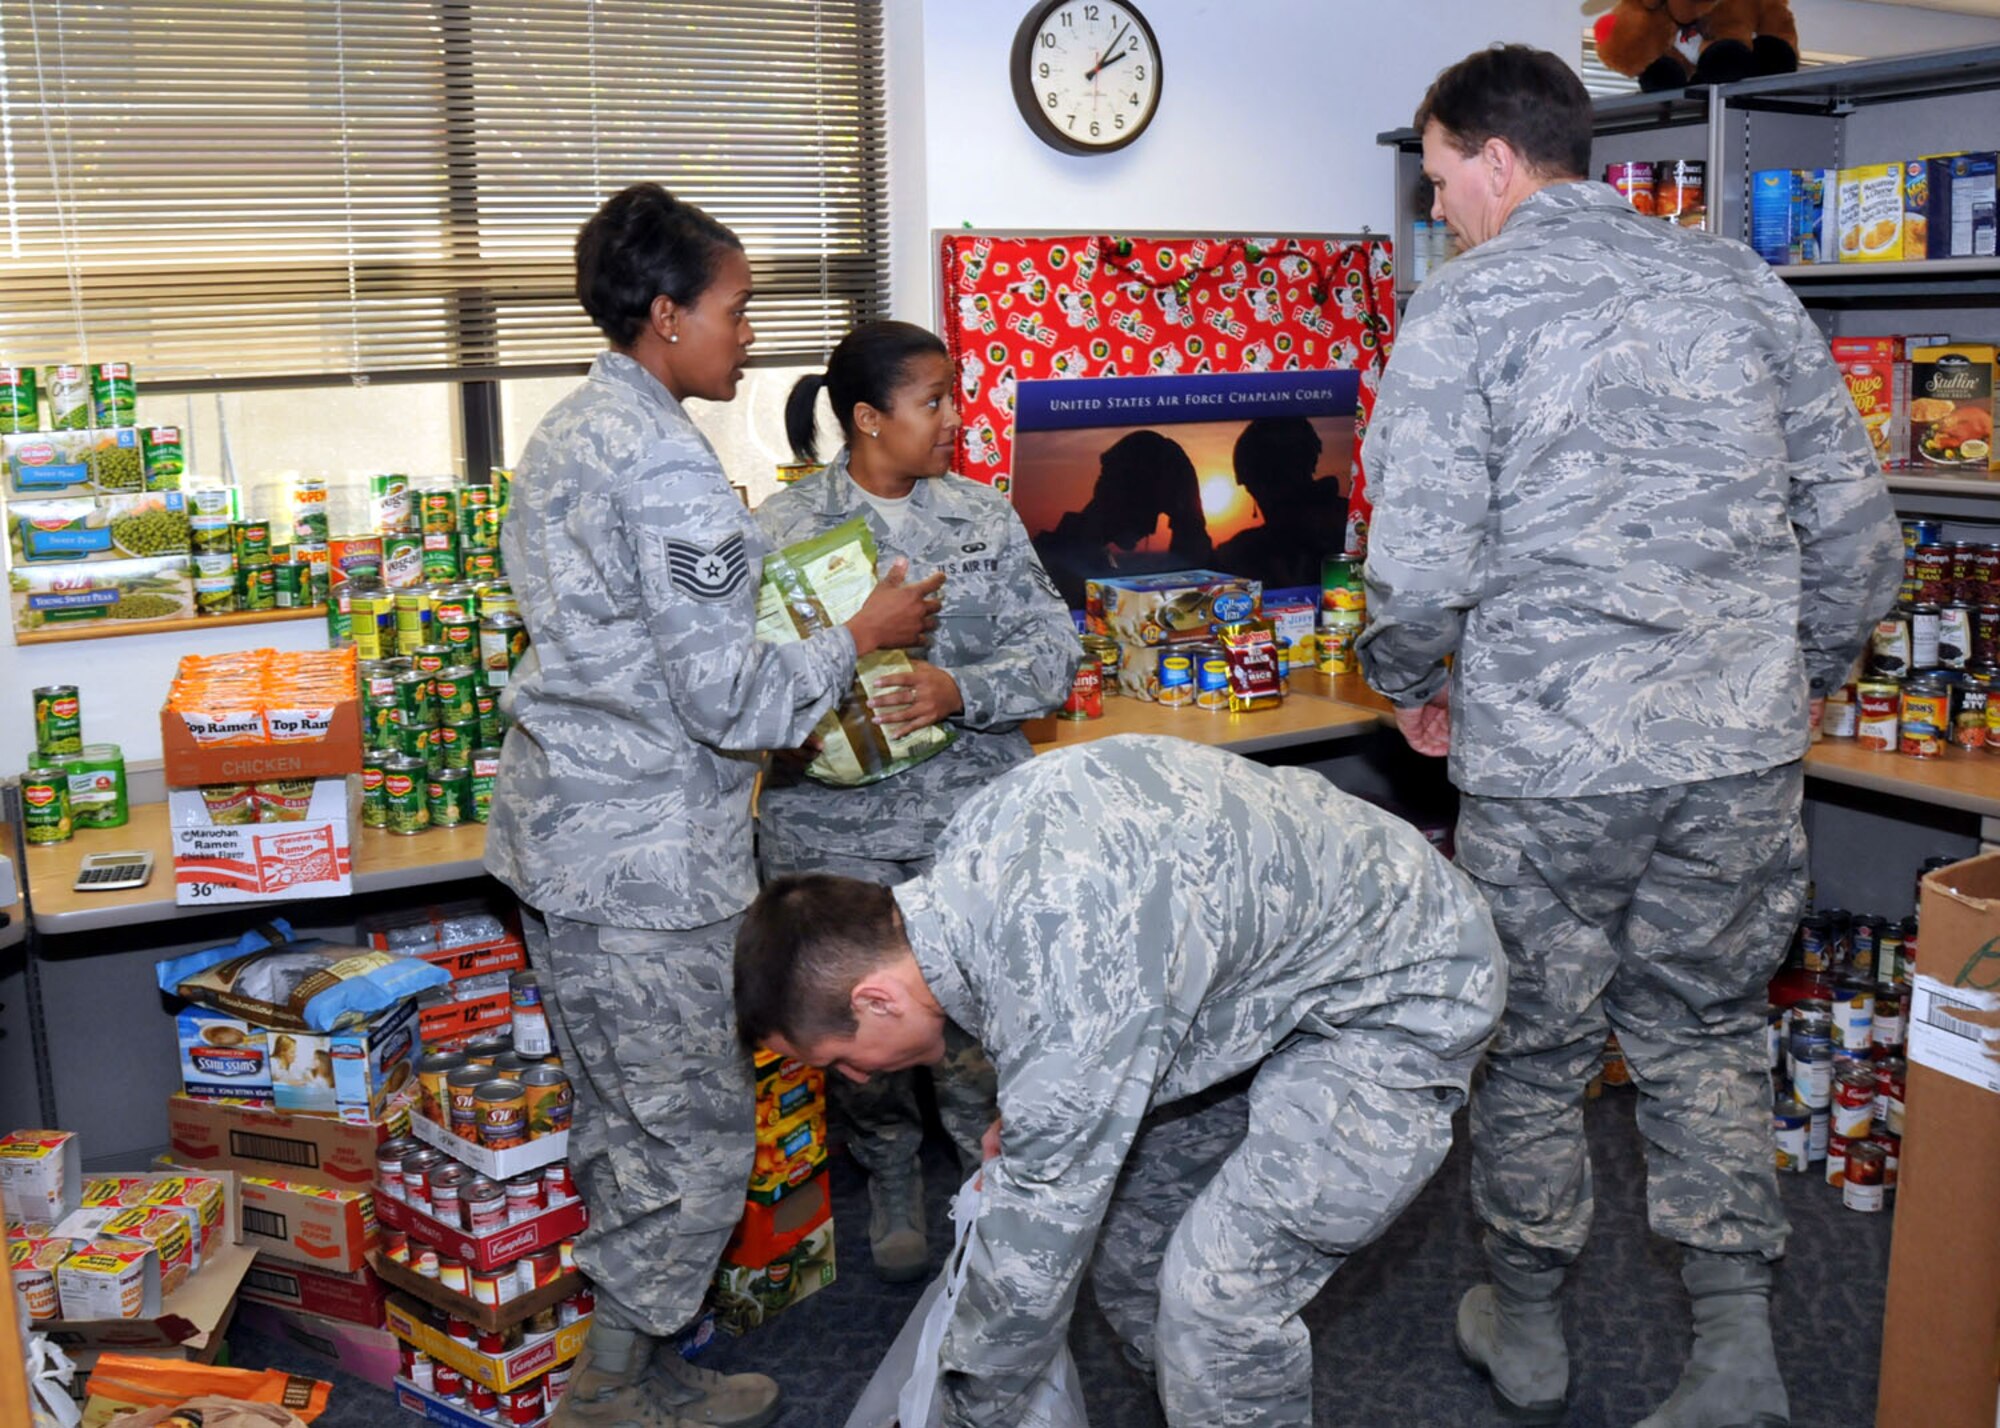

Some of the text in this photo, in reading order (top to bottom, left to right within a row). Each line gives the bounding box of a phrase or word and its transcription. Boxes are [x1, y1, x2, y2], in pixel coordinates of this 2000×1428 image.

[1060, 12, 1073, 27] 11
[1083, 5, 1099, 21] 12
[1111, 14, 1118, 30] 1
[1040, 32, 1056, 49] 10
[1128, 35, 1139, 51] 2
[1039, 63, 1050, 79] 9
[1135, 65, 1145, 81] 3
[1047, 92, 1058, 108] 8
[1129, 92, 1140, 107] 4
[1066, 115, 1076, 130] 7
[1089, 121, 1101, 137] 6
[1114, 114, 1125, 129] 5
[1050, 388, 1333, 411] UNITED STATES AIR FORCE CHAPLAIN CORPS
[121, 433, 129, 443] 6
[170, 494, 178, 505] 8
[962, 560, 980, 573] AIR
[207, 722, 258, 733] Ramen
[272, 719, 298, 731] Top
[221, 757, 301, 776] CHICKEN
[190, 829, 238, 838] Maruchan
[194, 840, 238, 850] Ramen
[276, 844, 314, 855] Ramen
[181, 850, 245, 862] Chicken Flavor
[190, 882, 212, 897] 36
[458, 953, 474, 970] 12
[464, 1006, 479, 1023] 12
[225, 1058, 257, 1073] SWISS
